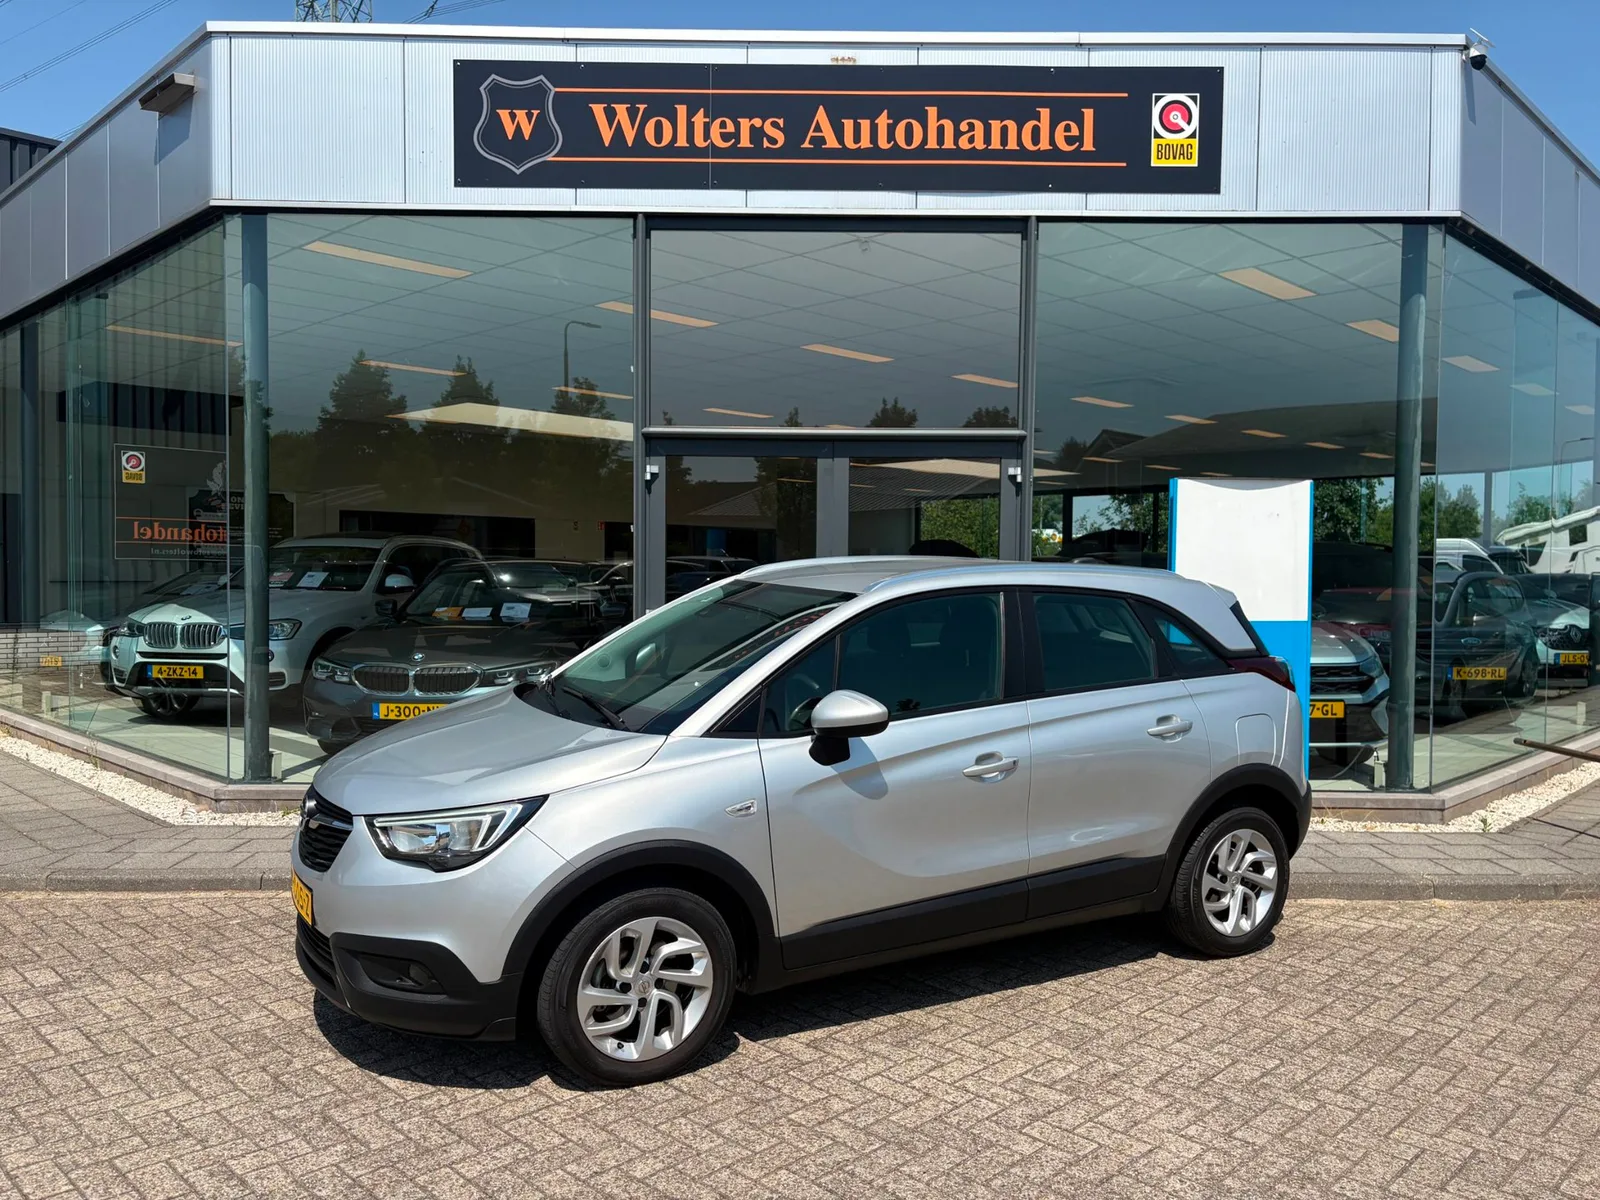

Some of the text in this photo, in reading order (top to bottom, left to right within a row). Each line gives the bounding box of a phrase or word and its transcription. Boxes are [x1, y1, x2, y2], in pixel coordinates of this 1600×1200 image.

[496, 109, 541, 141] W
[588, 103, 1096, 152] Wolters Autohandel
[1156, 142, 1193, 161] BOVAG
[157, 667, 198, 677] 4-ZKZ-14
[1456, 668, 1504, 678] K-698-RL
[383, 705, 439, 717] J-300-
[1310, 703, 1337, 716] 7-GL
